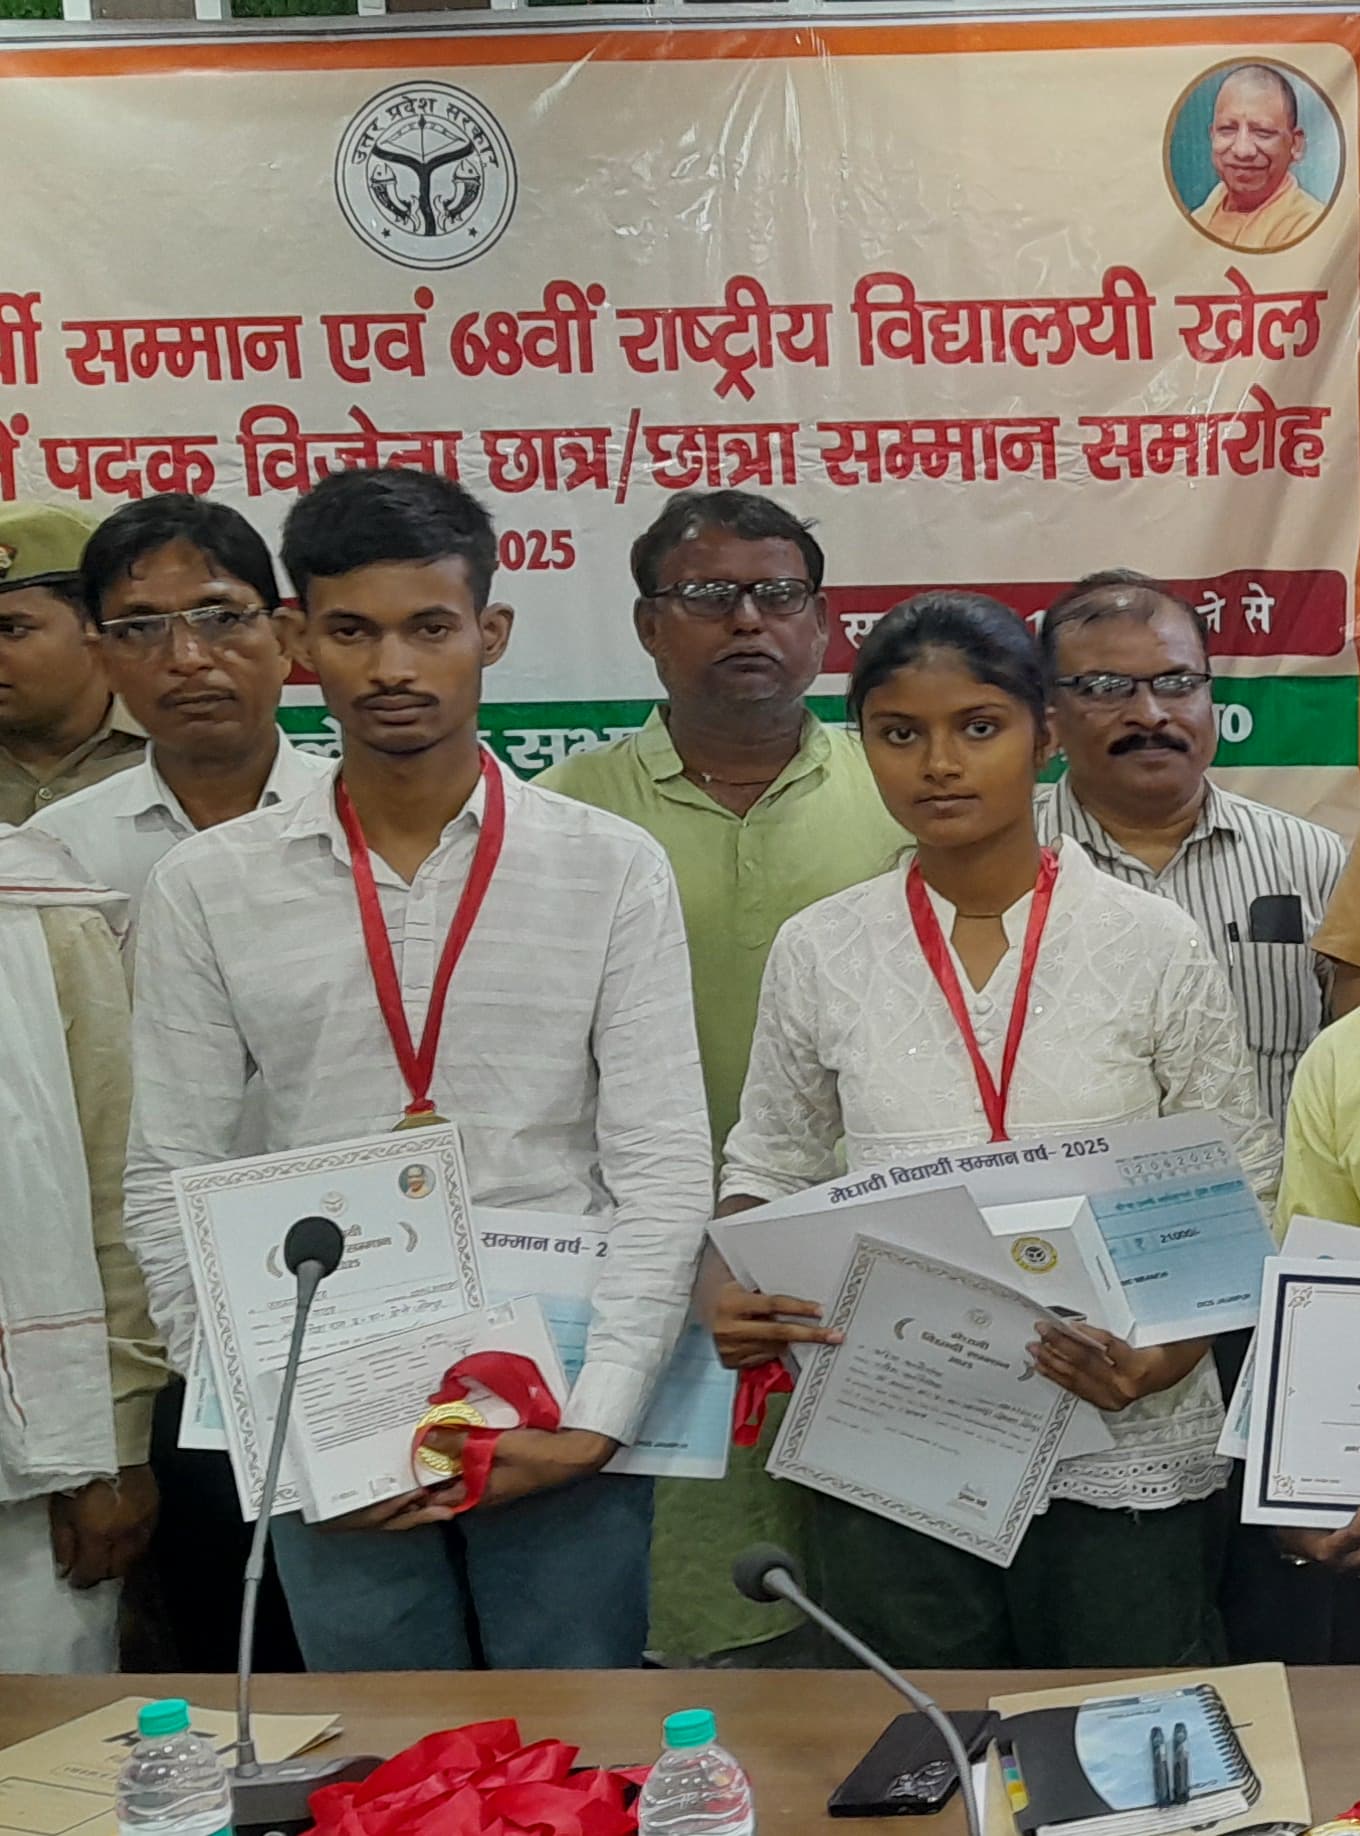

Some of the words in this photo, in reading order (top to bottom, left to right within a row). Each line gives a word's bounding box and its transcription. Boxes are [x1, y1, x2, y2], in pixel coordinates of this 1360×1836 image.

[62, 315, 302, 383] सम्मान
[320, 286, 436, 383] एवं
[450, 279, 607, 377] 68वीं
[618, 275, 833, 400] राष्ट्रीय
[851, 265, 1157, 367] विद्यालयी
[1175, 266, 1328, 363] खेल
[40, 435, 217, 501] पदक
[817, 417, 1060, 487] सम्मान
[1079, 384, 1331, 482] समारोह
[496, 529, 576, 571] 025
[1241, 581, 1275, 635] से
[1061, 1137, 1110, 1159] 2025
[480, 1231, 549, 1252] सम्मान
